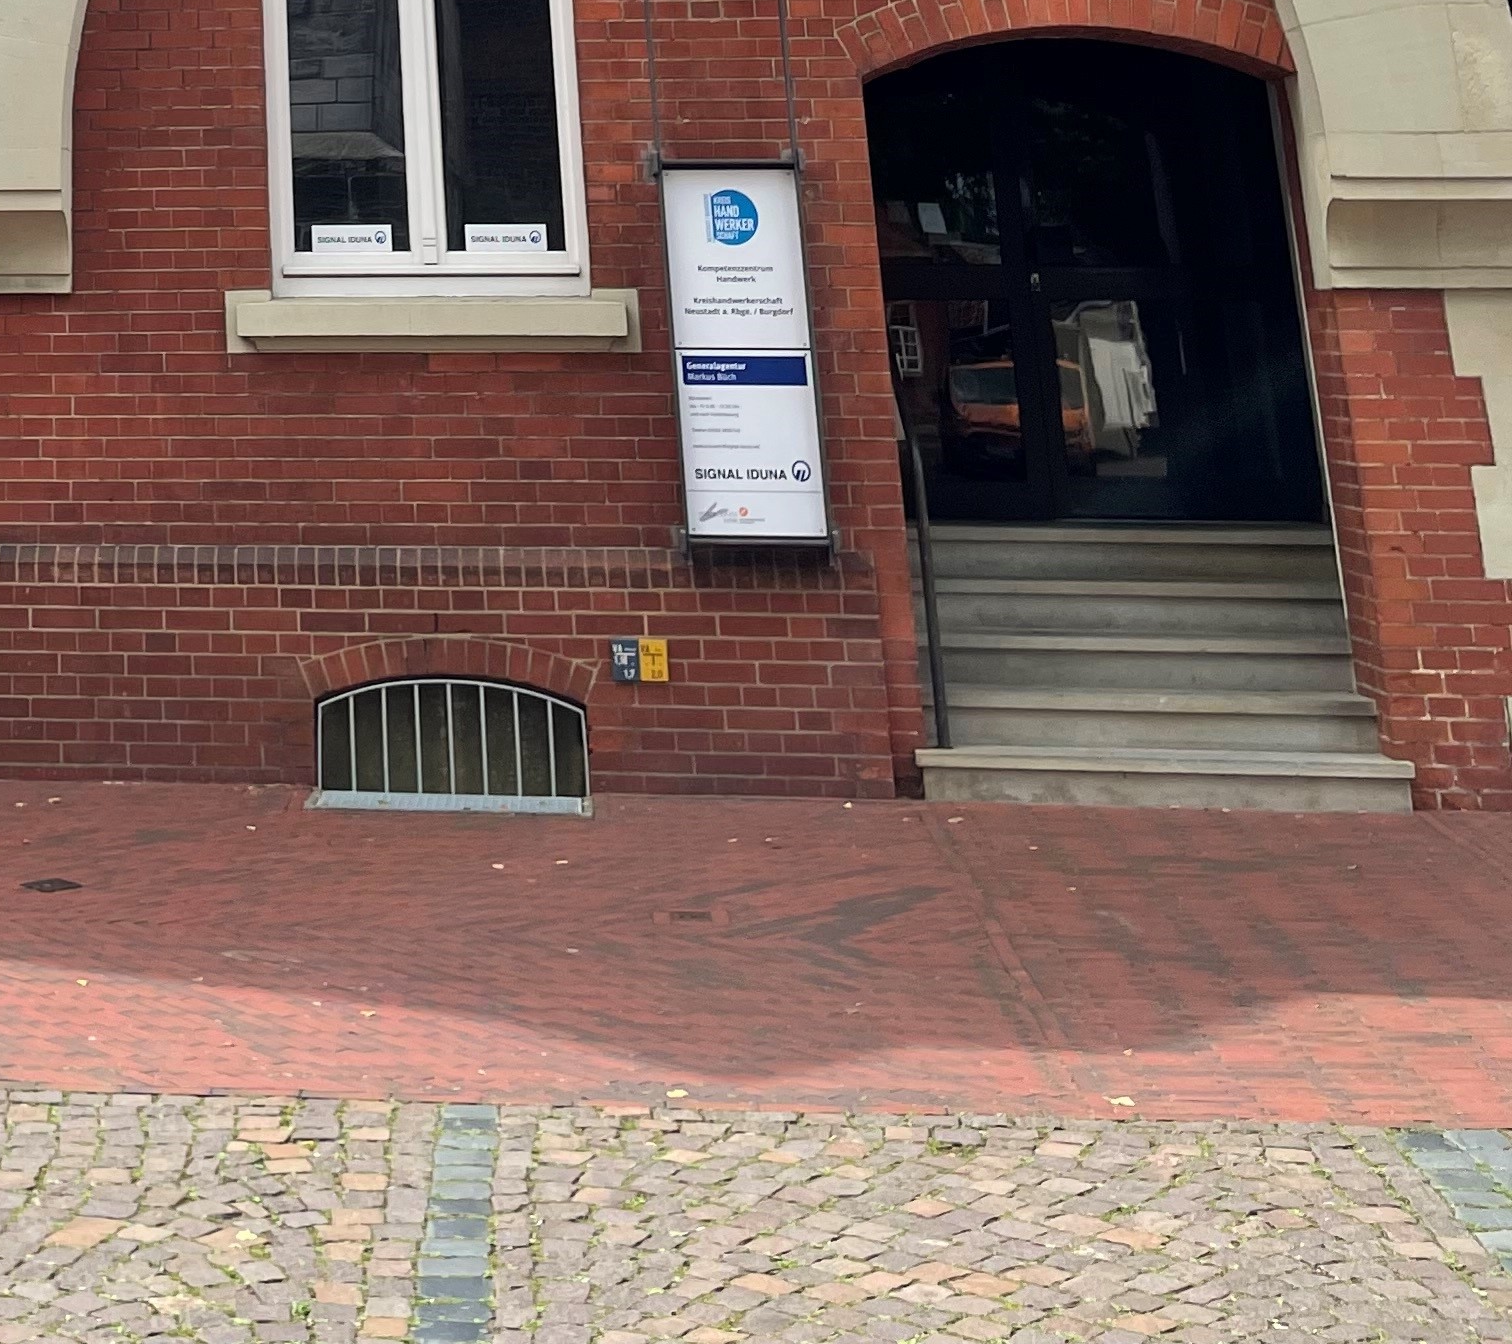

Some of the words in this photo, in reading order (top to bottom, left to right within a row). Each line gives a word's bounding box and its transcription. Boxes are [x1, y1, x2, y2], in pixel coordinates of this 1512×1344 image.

[714, 205, 740, 218] HAND
[715, 218, 755, 232] WERKER
[471, 235, 501, 243] SIGNAL
[502, 235, 527, 243] IDUNA
[697, 265, 774, 273] Kompetenzzentrum
[716, 275, 757, 283] Handwerk
[693, 297, 783, 305] Kreishandwerkerschaft
[684, 307, 721, 315] Neustadt
[759, 308, 794, 317] Burgdorf
[686, 361, 747, 372] Generalagentur
[687, 373, 716, 381] Markus
[694, 468, 744, 480] SIGNAL
[746, 469, 788, 480] IDUNA
